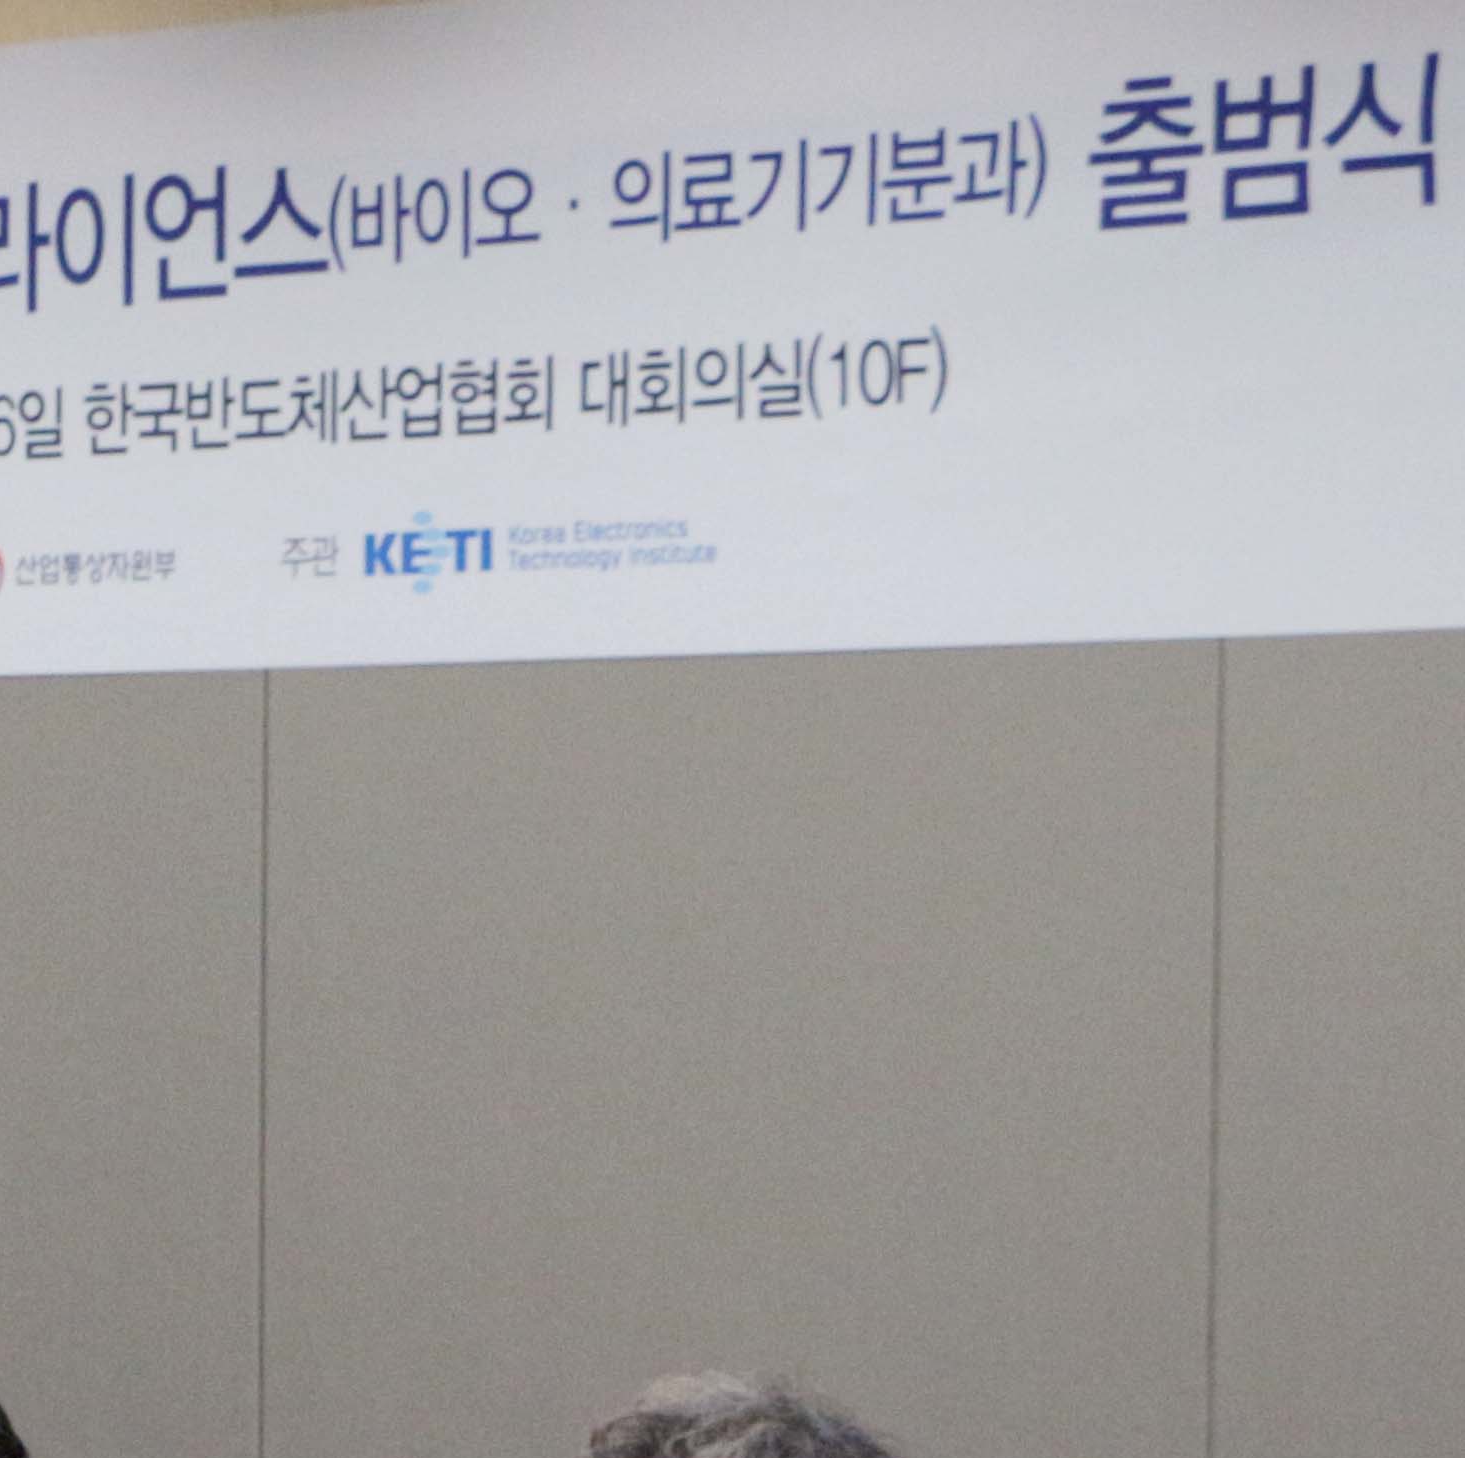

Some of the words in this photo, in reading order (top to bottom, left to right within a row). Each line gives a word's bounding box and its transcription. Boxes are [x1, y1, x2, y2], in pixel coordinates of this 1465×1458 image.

[609, 114, 1048, 243] 의료기기분과)
[1088, 52, 1440, 230] 출범식
[84, 355, 554, 456] 한국반도체산업협회
[579, 325, 948, 427] 대회의실(10F)
[364, 528, 493, 576] KETI
[508, 525, 567, 544] Korea
[573, 520, 689, 542] Electronics
[15, 550, 176, 586] 산업통상자원부
[280, 535, 340, 578] 주관
[508, 549, 622, 571] Technology
[629, 545, 718, 566] Institute
